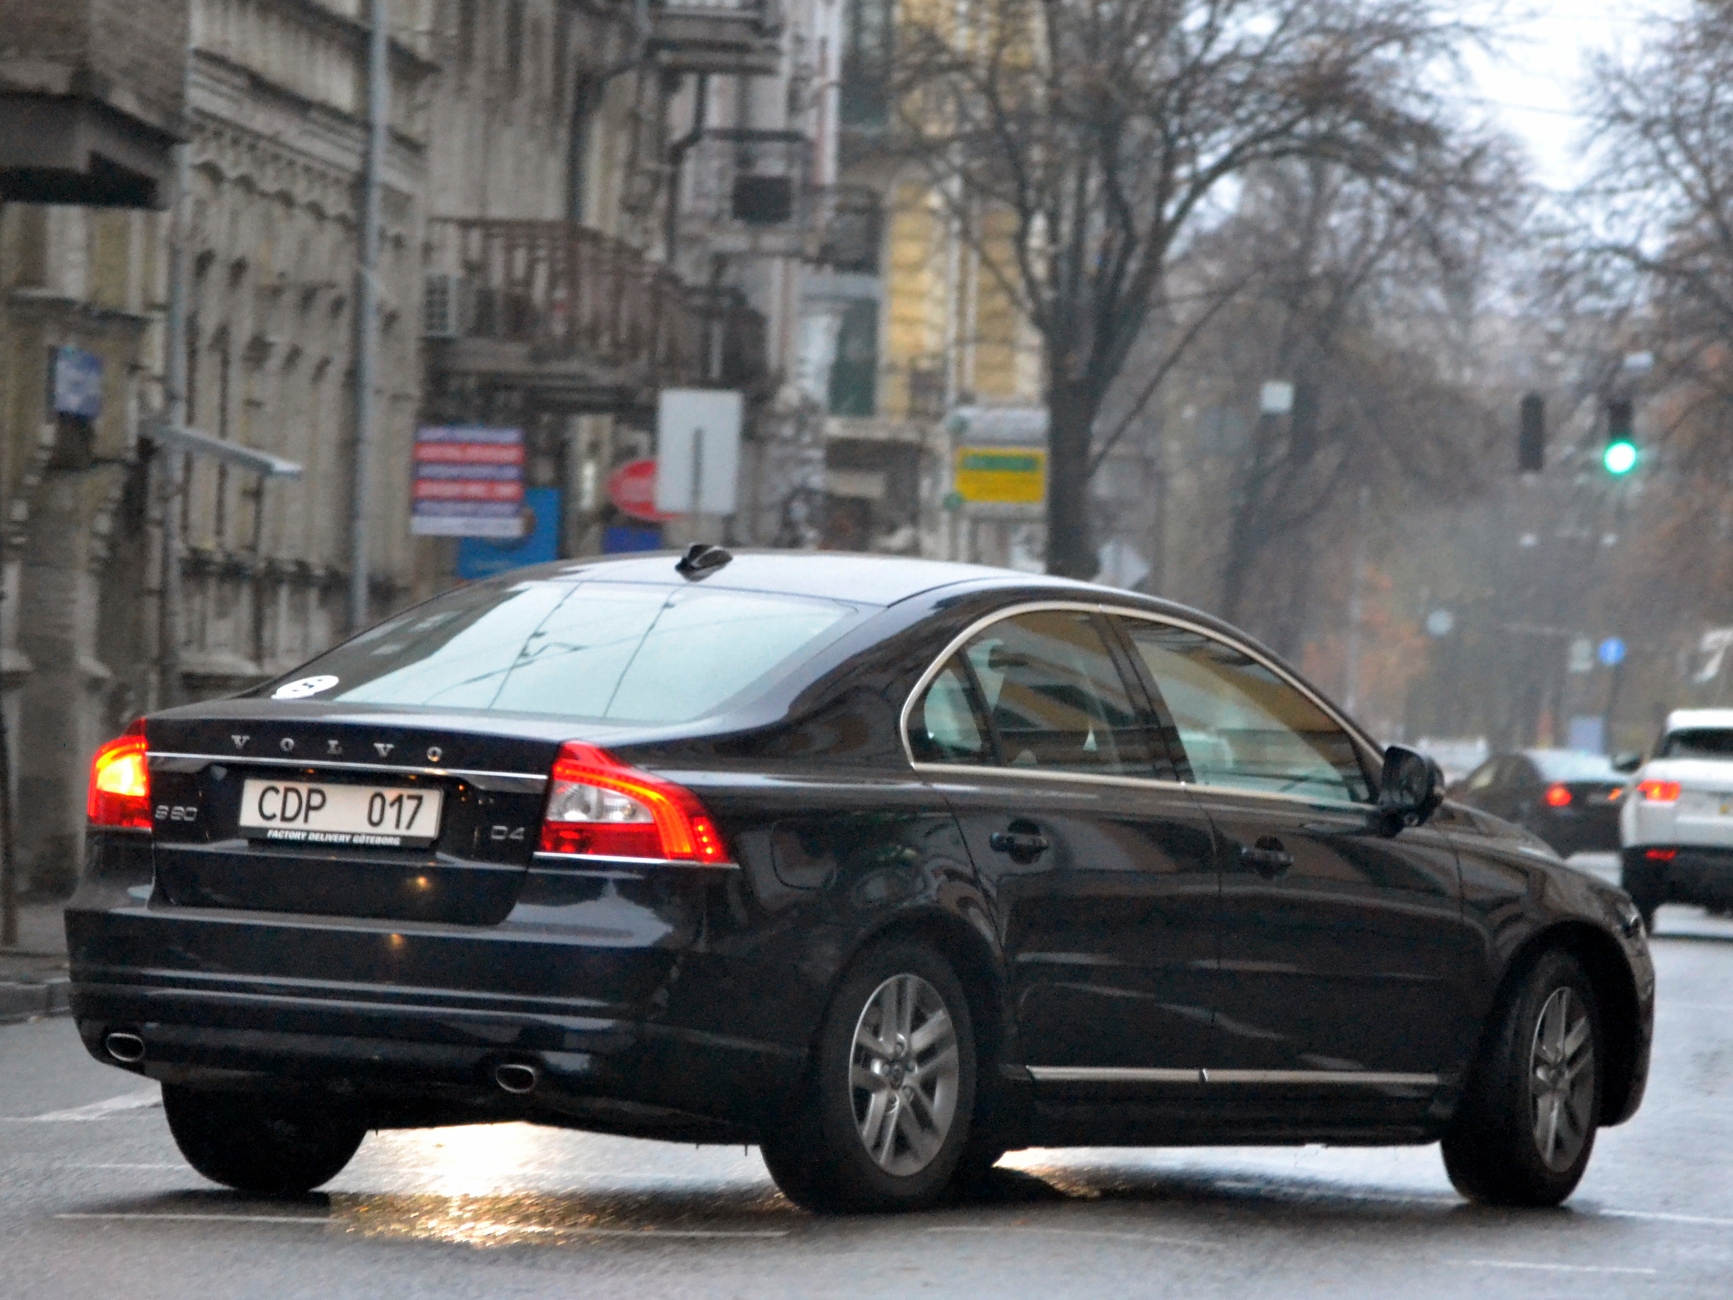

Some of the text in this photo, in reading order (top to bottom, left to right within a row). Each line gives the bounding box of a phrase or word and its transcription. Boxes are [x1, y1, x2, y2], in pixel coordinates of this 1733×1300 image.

[231, 734, 443, 762] VOLVO
[154, 804, 198, 822] S80
[258, 785, 424, 830] CDP 017
[267, 829, 401, 846] FACTORY DELIVERY GÖTEBORG
[490, 825, 526, 841] D4
